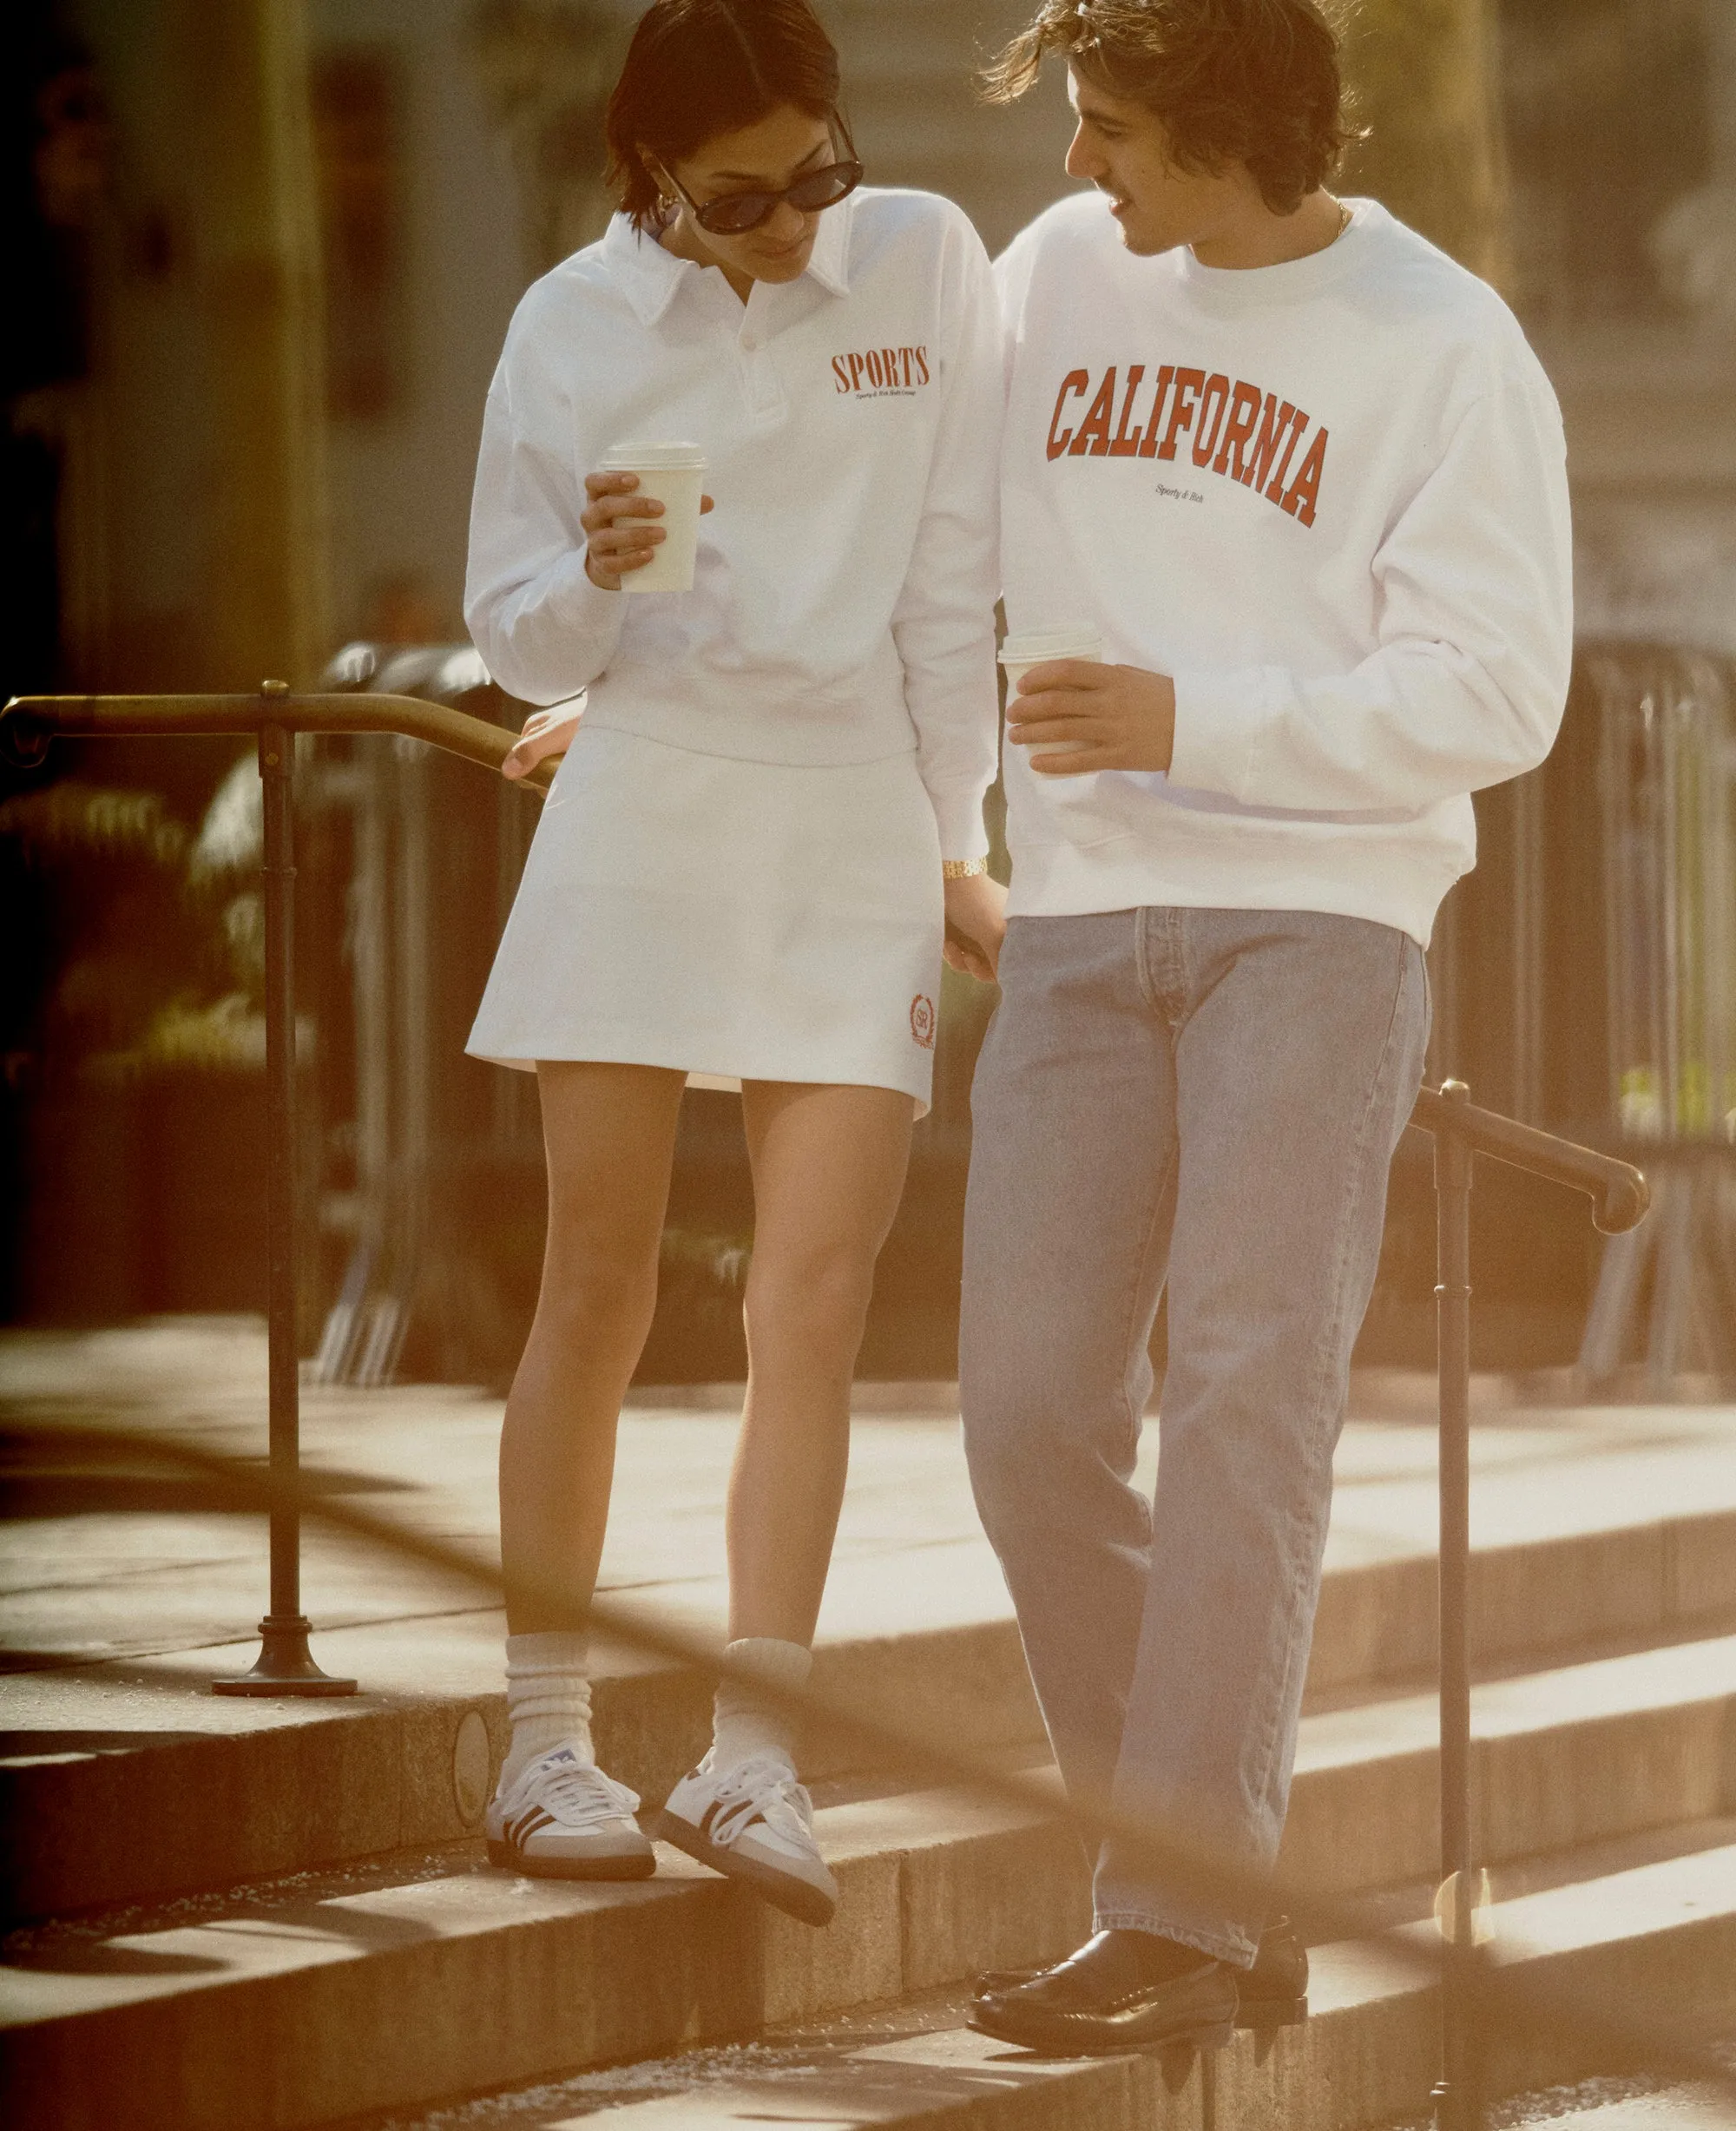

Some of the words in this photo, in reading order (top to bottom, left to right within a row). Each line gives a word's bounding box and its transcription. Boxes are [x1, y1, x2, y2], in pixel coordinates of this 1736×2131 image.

[832, 345, 930, 394] SPORTS
[1046, 365, 1329, 529] CALIFORNIA
[1155, 483, 1180, 500] Sporty
[1181, 490, 1189, 500] &
[1189, 491, 1204, 504] Rich
